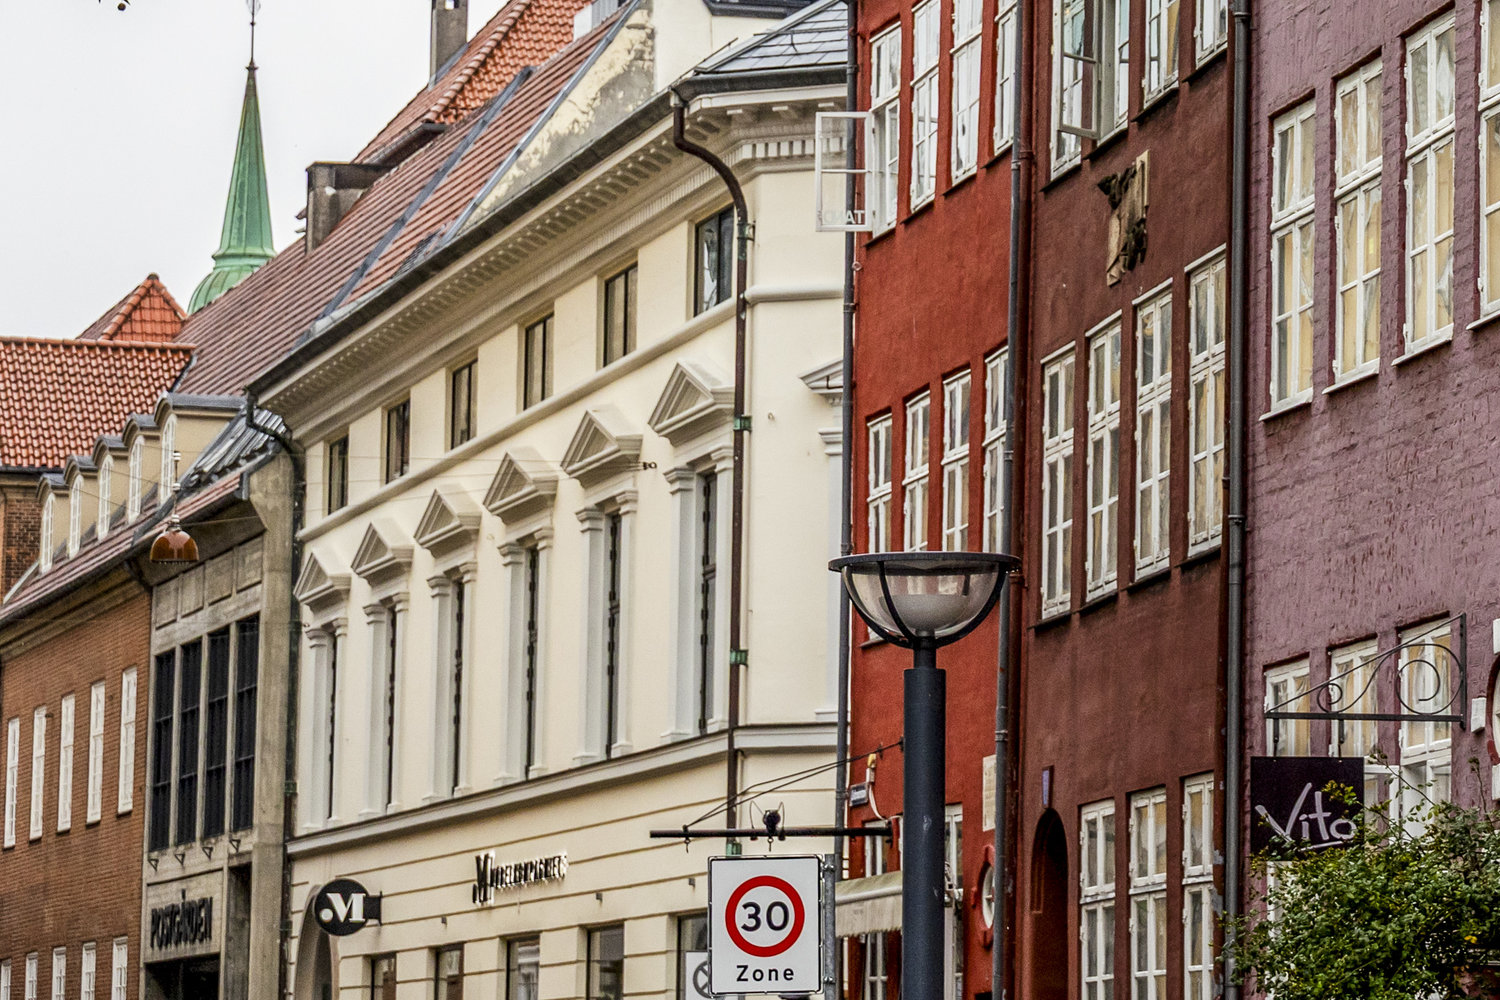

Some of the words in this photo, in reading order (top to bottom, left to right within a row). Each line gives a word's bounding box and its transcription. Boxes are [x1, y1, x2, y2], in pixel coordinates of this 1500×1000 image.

[1255, 782, 1357, 843] Vito
[740, 900, 790, 932] 30
[736, 964, 795, 982] Zone
